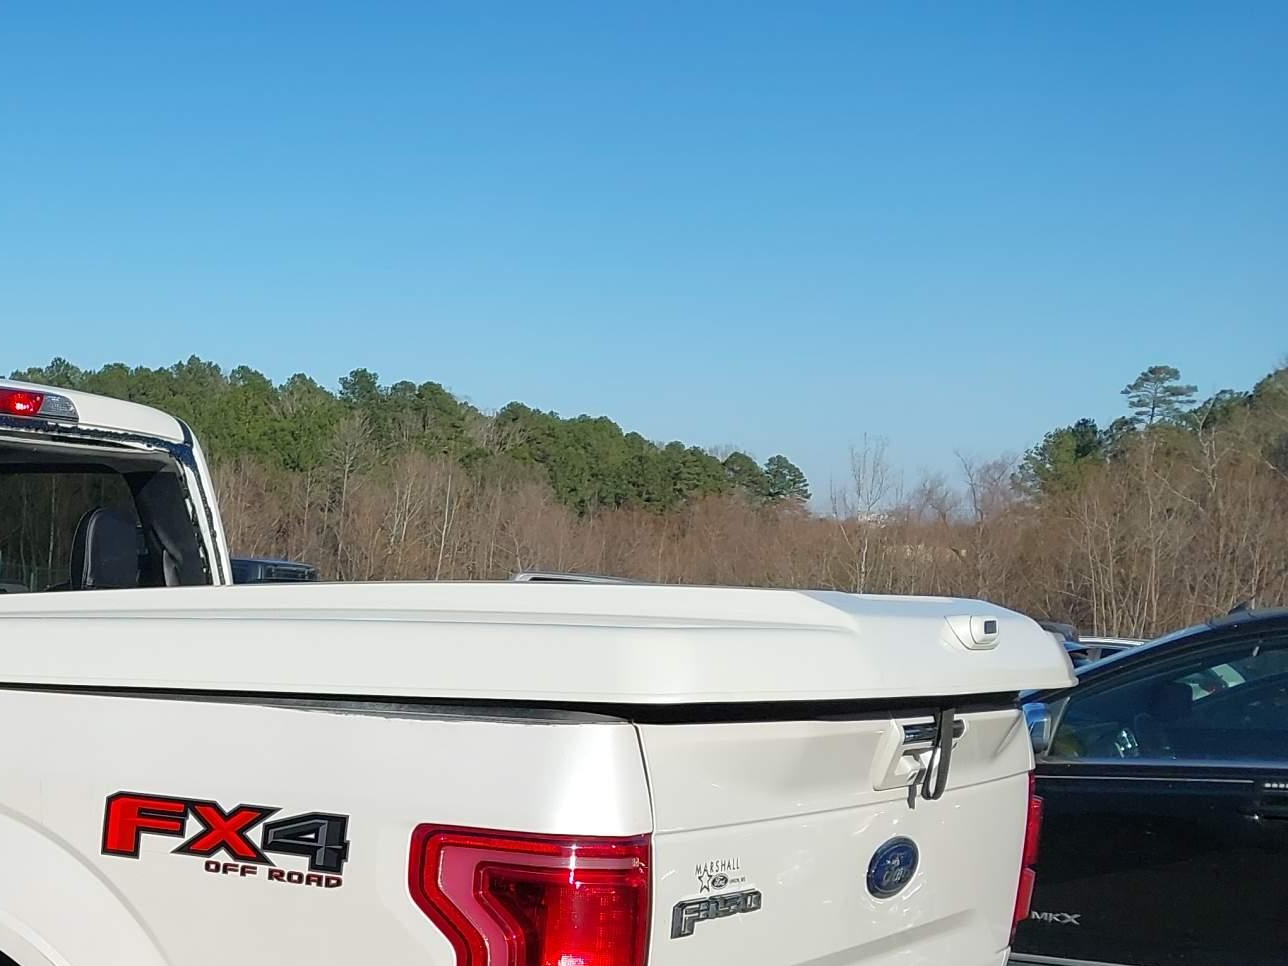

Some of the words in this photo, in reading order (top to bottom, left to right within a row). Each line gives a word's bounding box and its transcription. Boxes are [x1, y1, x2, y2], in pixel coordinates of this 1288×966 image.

[101, 791, 350, 876] FX4
[204, 860, 258, 878] OFF
[267, 867, 344, 889] ROAD
[695, 857, 740, 875] MARSHALL
[1030, 910, 1082, 926] MKX
